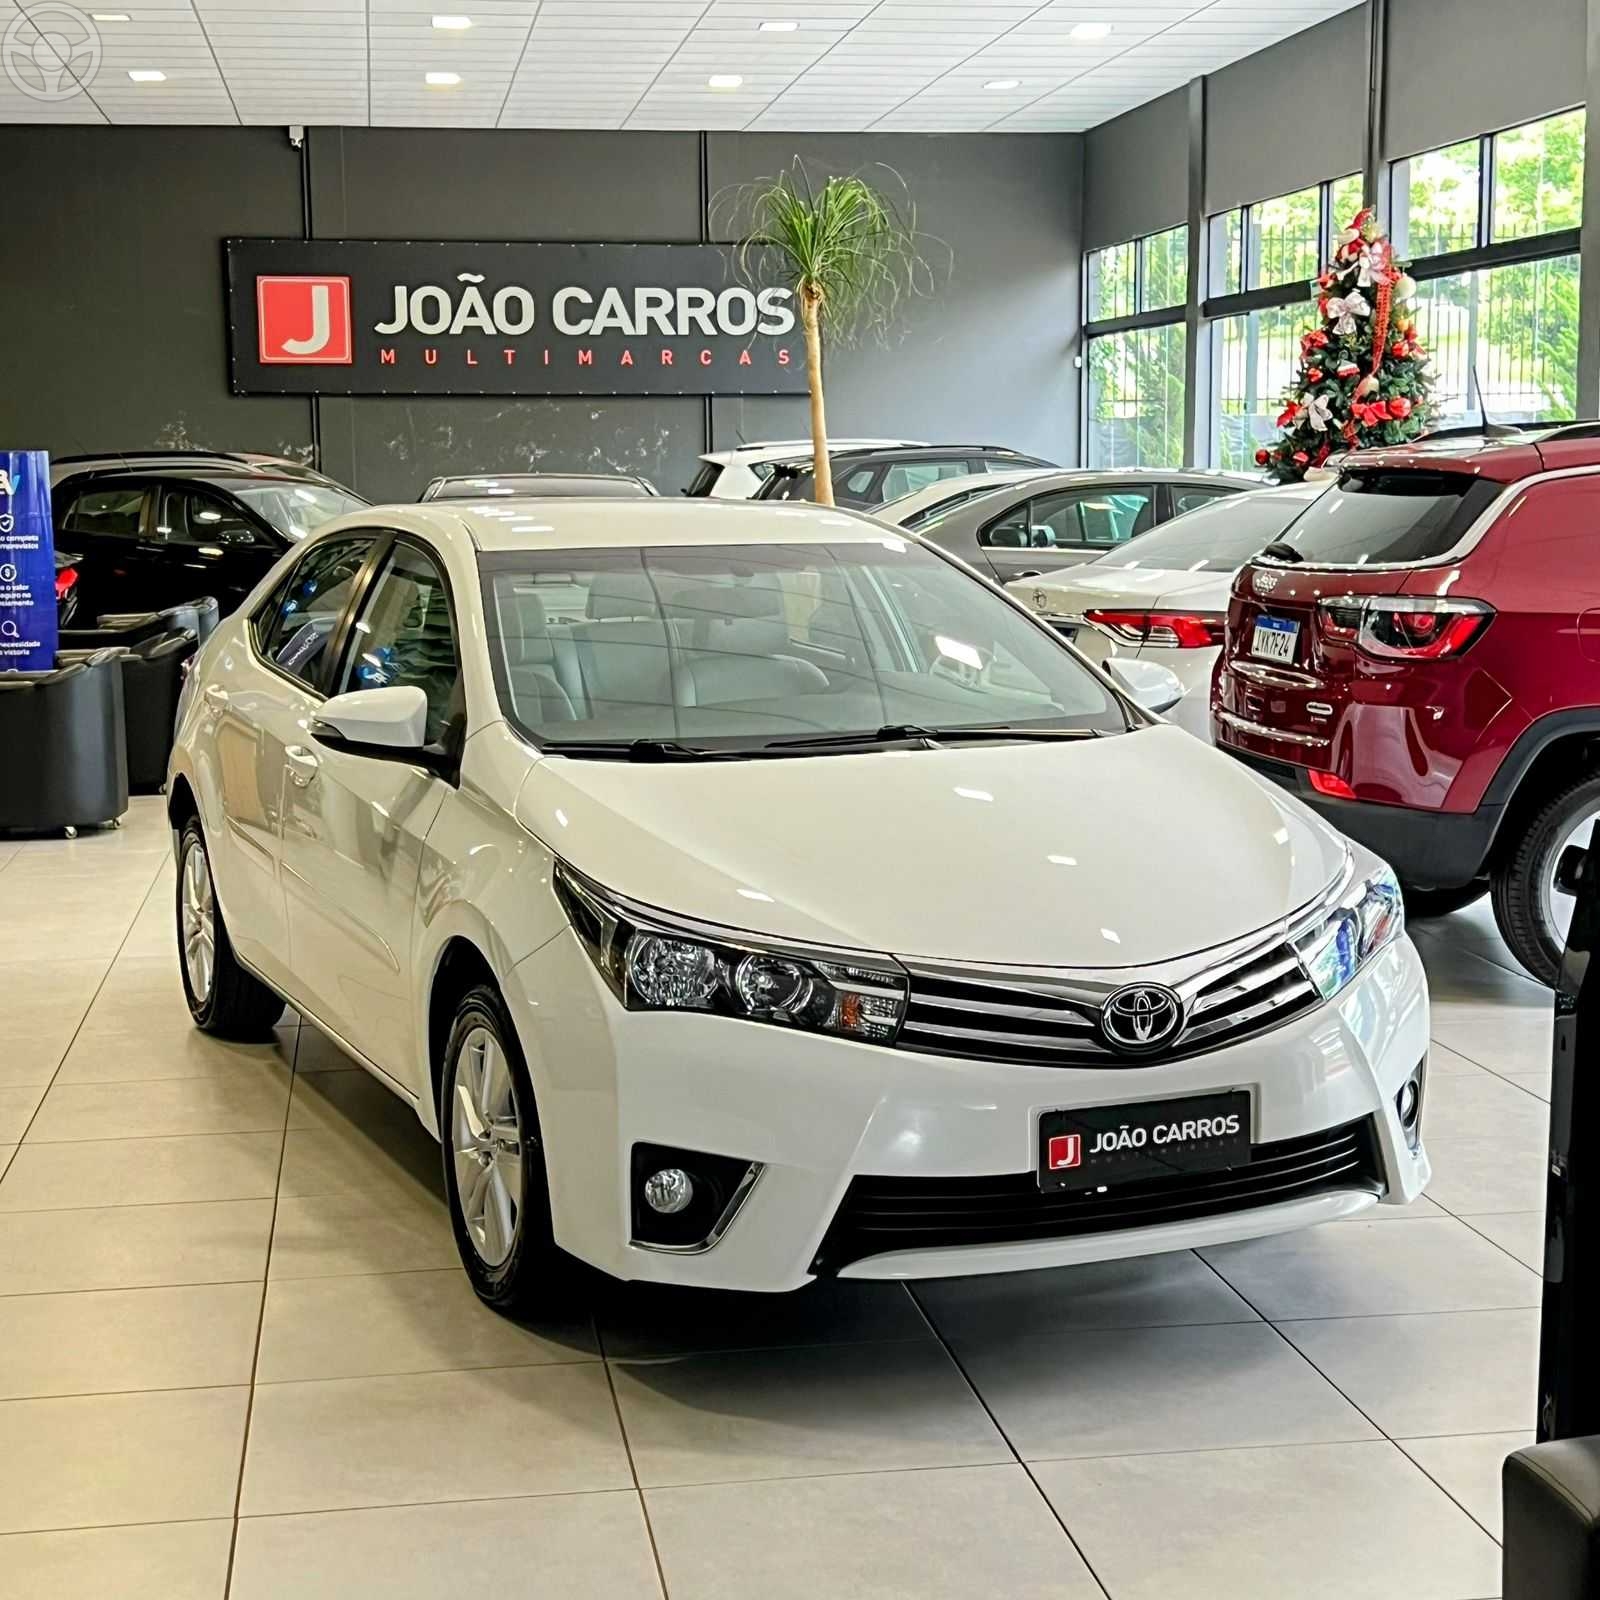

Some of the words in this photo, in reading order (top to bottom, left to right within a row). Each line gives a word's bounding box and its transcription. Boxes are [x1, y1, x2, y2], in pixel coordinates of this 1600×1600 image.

[281, 285, 330, 354] J
[374, 273, 535, 335] JOÃO
[552, 286, 795, 336] CARROS
[380, 348, 790, 366] MULTIMARCAS
[1056, 1137, 1075, 1166] J
[1089, 1125, 1147, 1154] JOÃO
[1152, 1114, 1240, 1145] CARROS
